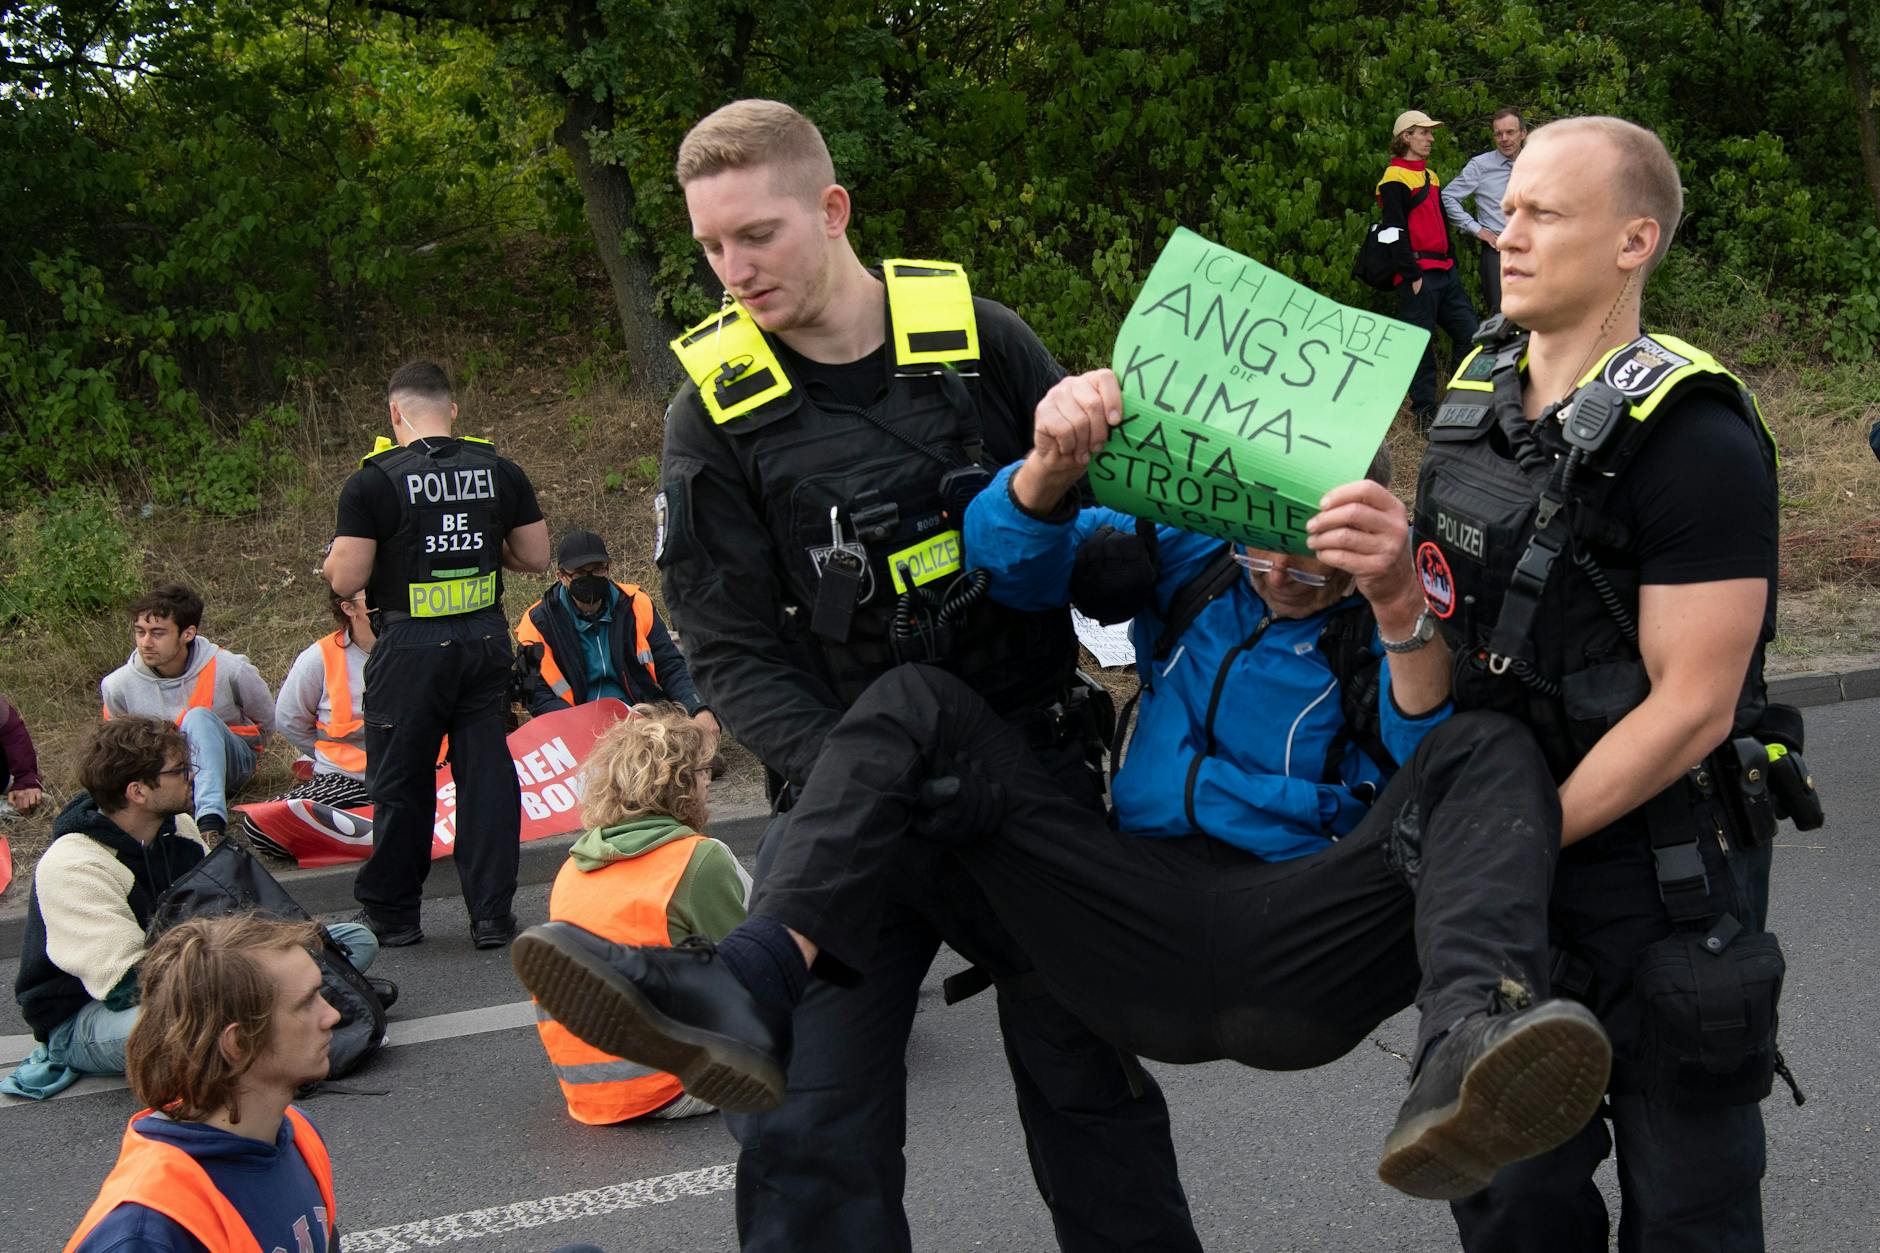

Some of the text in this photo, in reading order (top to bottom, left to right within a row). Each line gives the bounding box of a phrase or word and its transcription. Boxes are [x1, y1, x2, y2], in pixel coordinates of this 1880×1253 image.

[1193, 248, 1407, 360] ICH HABE
[1140, 283, 1375, 402] ANGST
[1229, 365, 1258, 384] DIE
[1119, 345, 1332, 455] KLIMA-
[1107, 413, 1278, 493] KATA-
[406, 468, 496, 505] POLIZEI
[1095, 451, 1310, 535] STROPHE
[425, 532, 484, 553] 35125
[442, 513, 469, 532] BE
[1437, 512, 1484, 559] POLIZEI
[412, 574, 496, 616] POLIZEI
